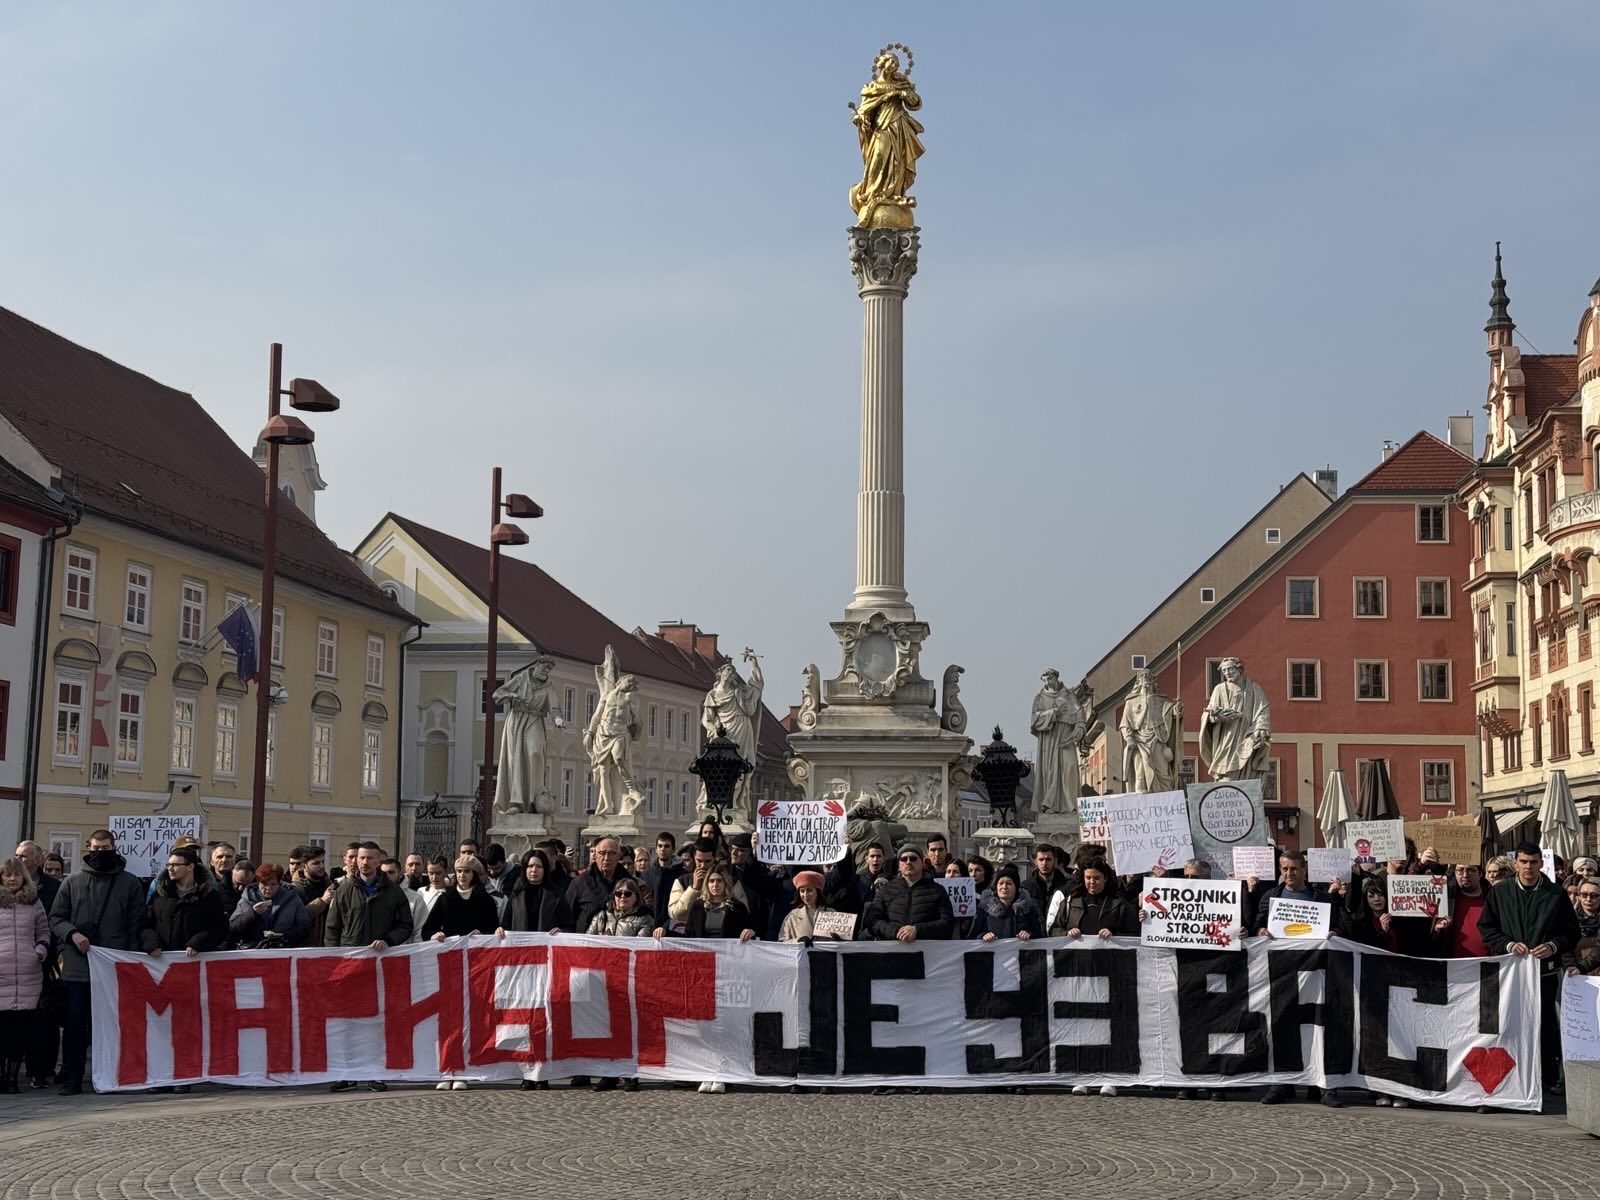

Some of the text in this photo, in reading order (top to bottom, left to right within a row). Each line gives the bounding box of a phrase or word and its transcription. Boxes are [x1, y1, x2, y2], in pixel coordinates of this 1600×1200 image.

[787, 803, 819, 816] ХУЉО
[114, 817, 195, 829] NISAM ZNALA
[760, 817, 840, 831] НЕБИТАН СИ СТВОР
[1120, 820, 1174, 836] ТАМО ГДЕ
[111, 829, 194, 841] DA SI TAKVA
[765, 830, 839, 845] НЕМА ДИЈАЛОГА
[1083, 825, 1111, 839] STU
[760, 845, 842, 862] МАРШ У ЗАТВОР
[1113, 840, 1146, 854] СТРАХ
[1151, 887, 1236, 905] STROJNIKI
[1170, 903, 1205, 913] PROTI
[1150, 910, 1233, 923] POKVARJENEMU
[1166, 922, 1216, 936] STROJU
[1146, 935, 1195, 944] SLOVENAČKA
[116, 946, 717, 1085] МАРИБОР
[754, 949, 926, 1077] ЈЕ
[964, 947, 1141, 1075] УЗ
